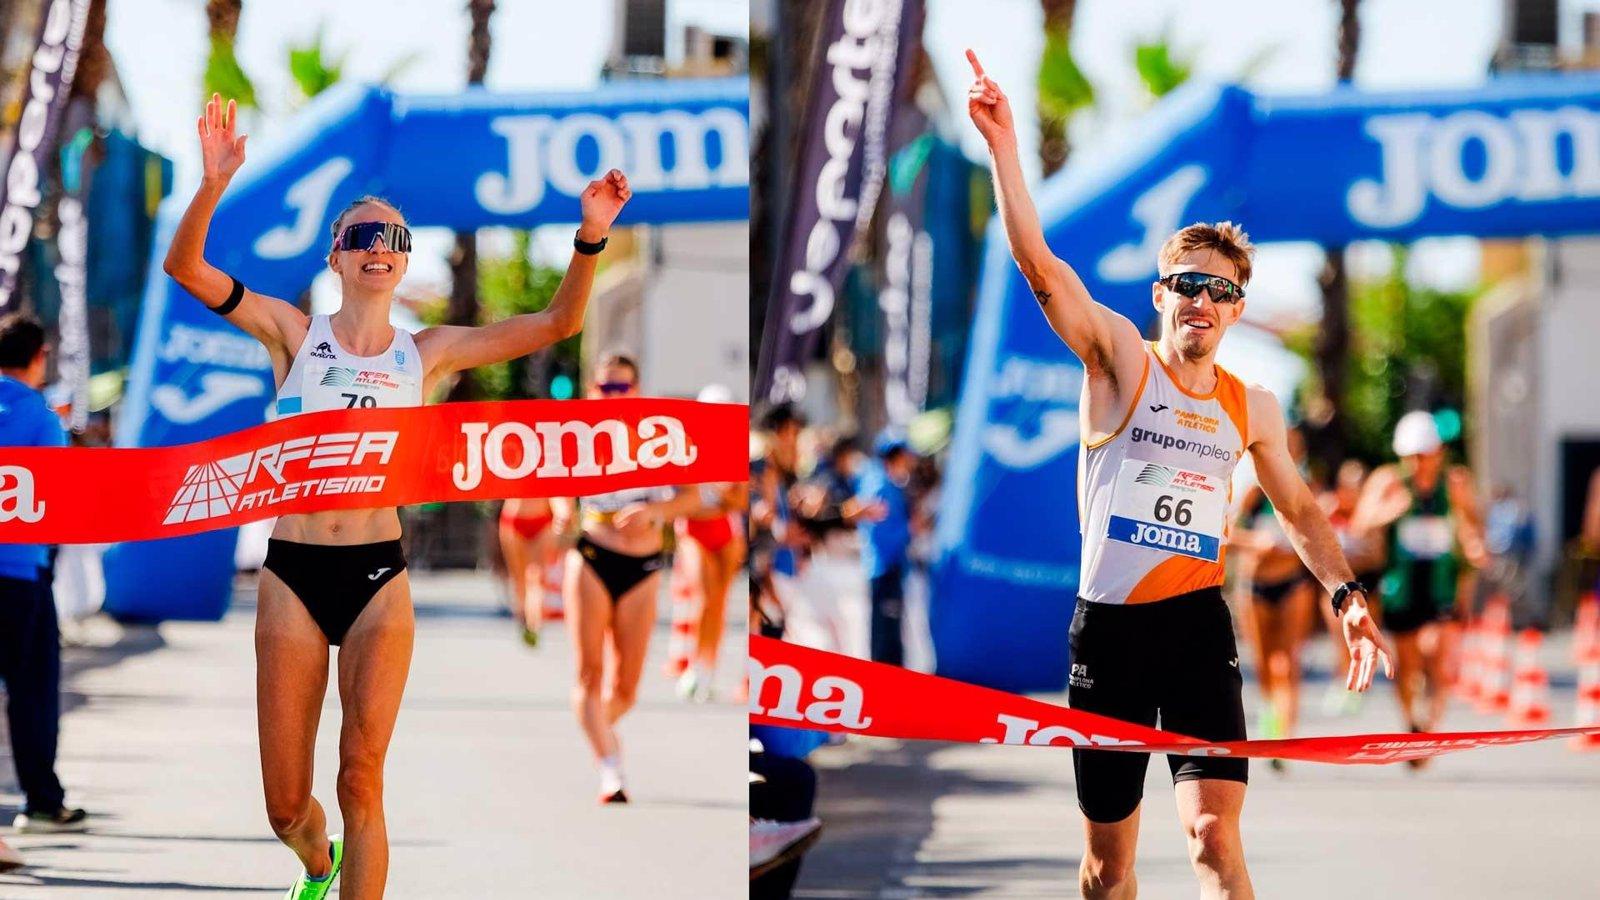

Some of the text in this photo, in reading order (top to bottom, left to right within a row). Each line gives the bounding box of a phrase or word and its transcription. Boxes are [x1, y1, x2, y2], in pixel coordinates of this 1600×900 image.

[1174, 409, 1219, 425] PAMPLONA
[246, 431, 399, 484] RFEA
[1131, 426, 1231, 462] grupompleo
[237, 475, 387, 512] ATLETISMO
[1153, 495, 1193, 526] 66
[1071, 663, 1087, 677] PA
